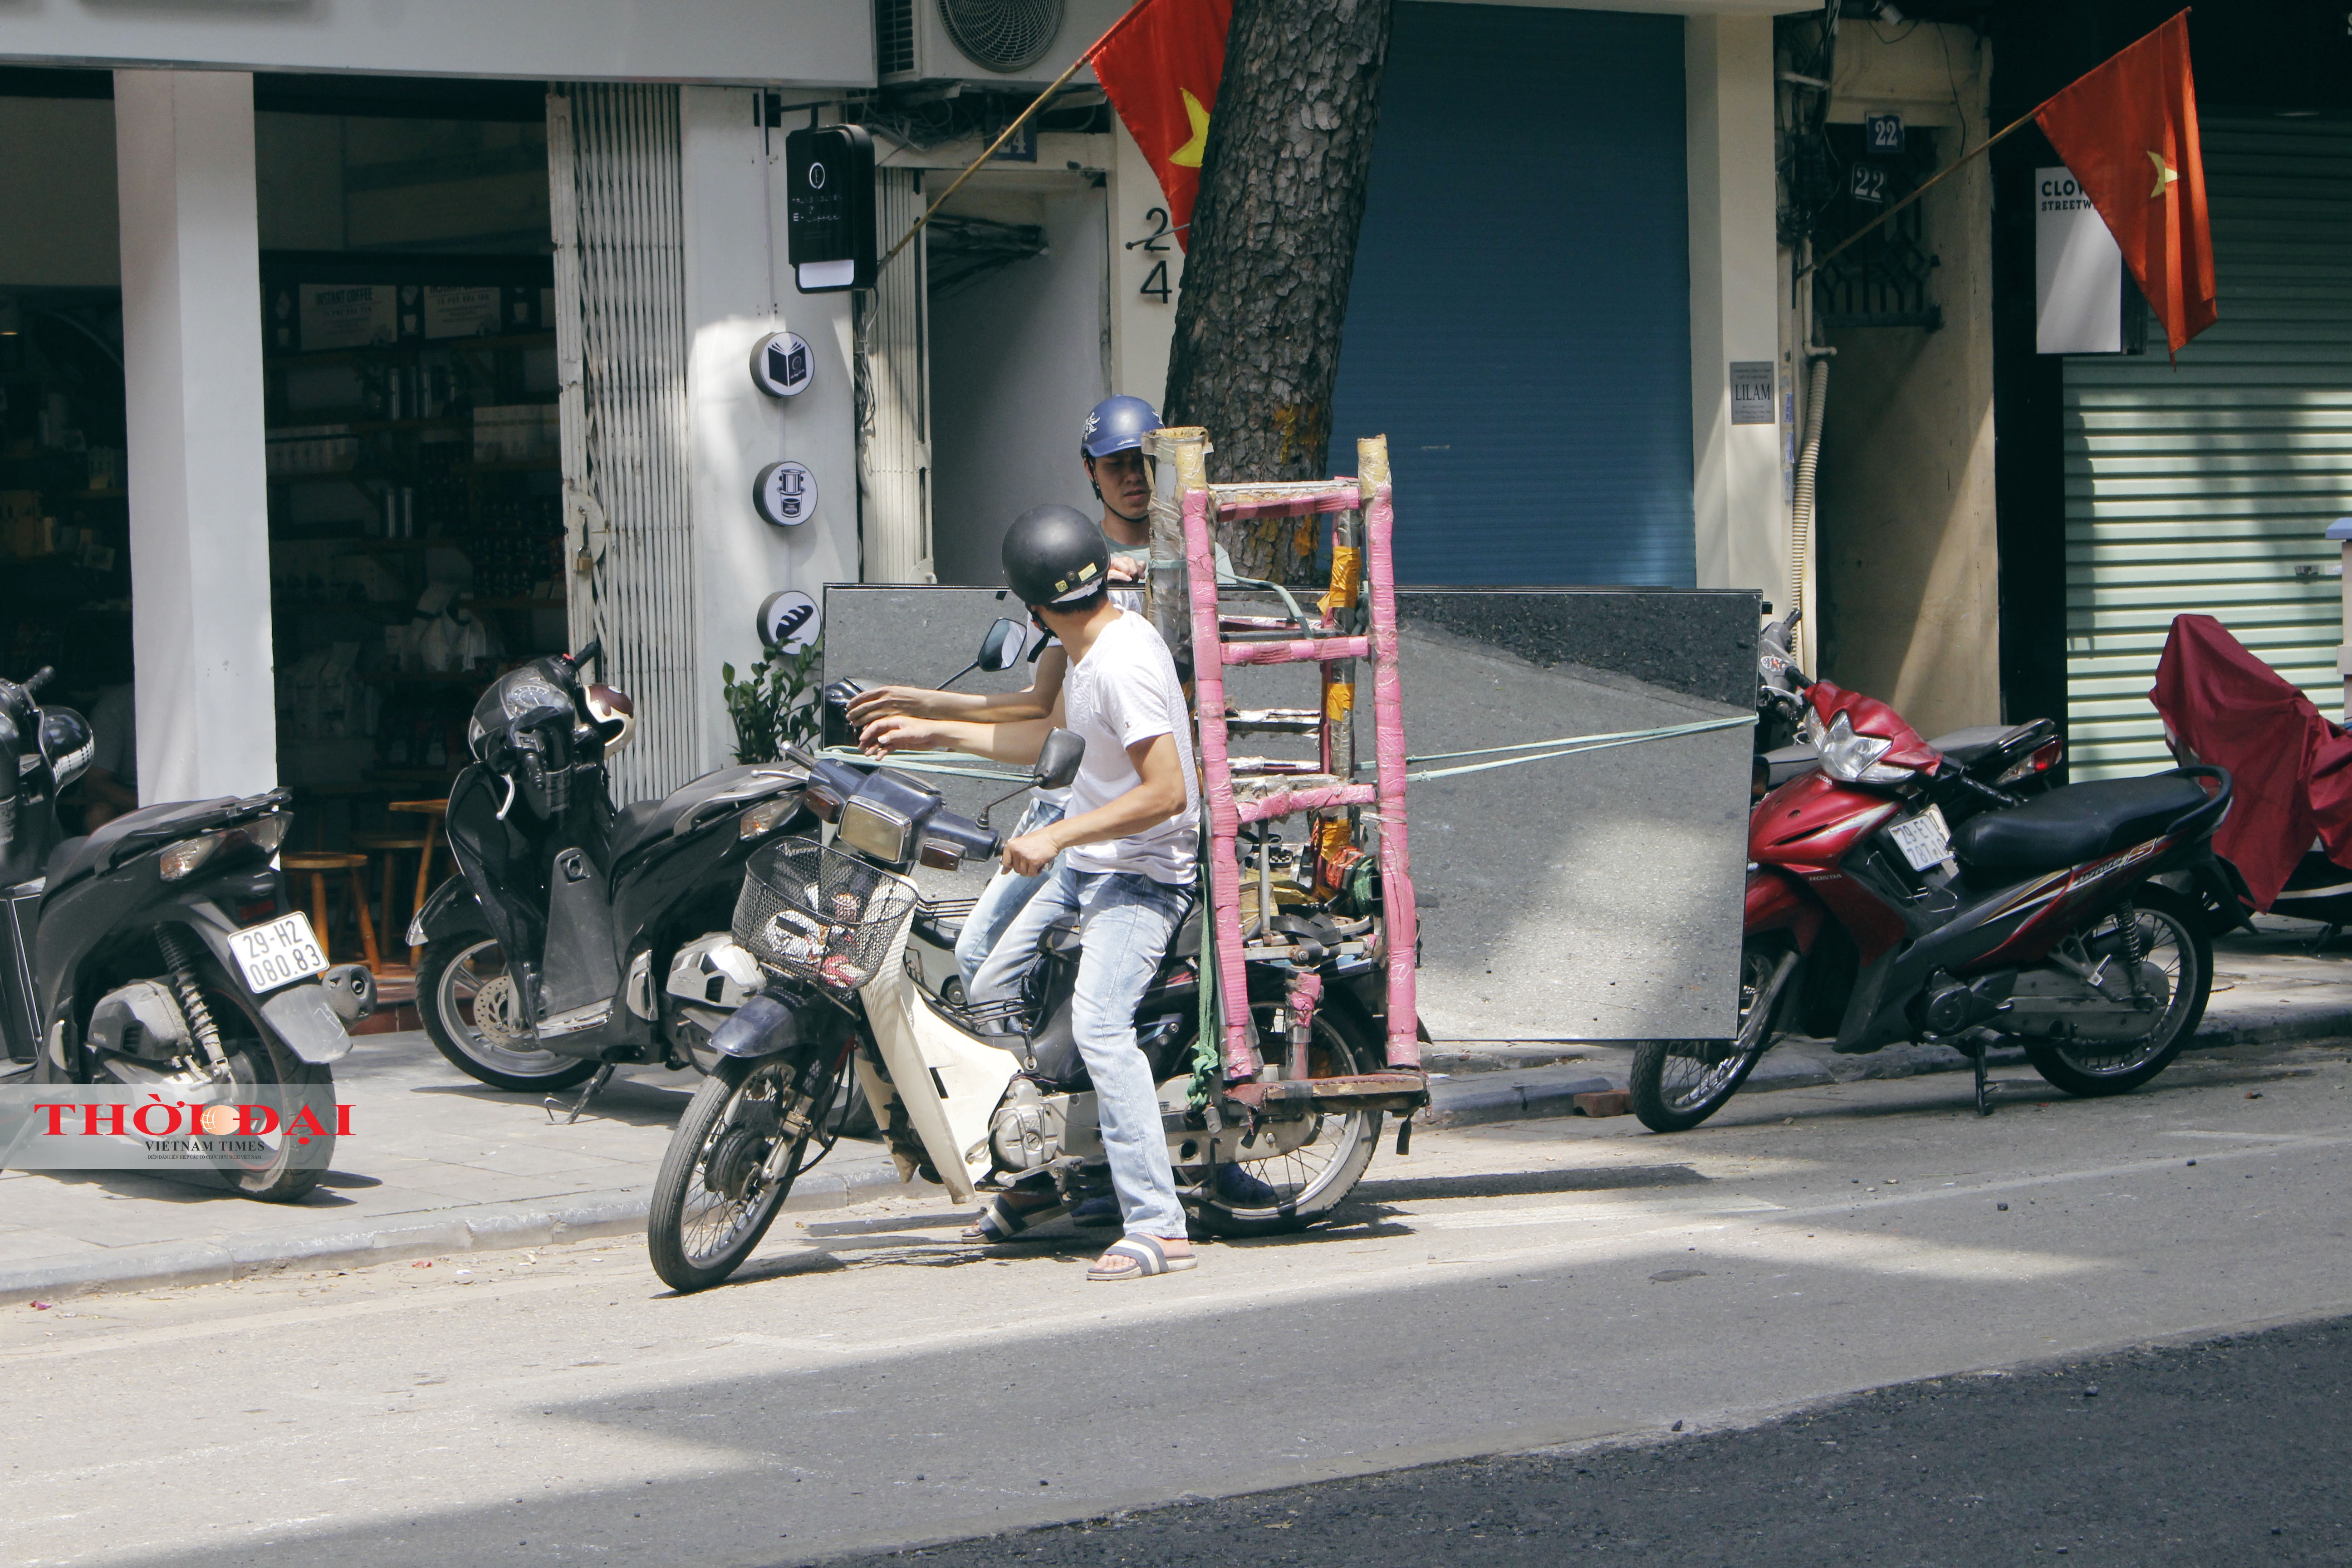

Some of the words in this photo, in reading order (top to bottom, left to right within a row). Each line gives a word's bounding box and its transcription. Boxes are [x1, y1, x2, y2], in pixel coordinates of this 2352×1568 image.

[1875, 120, 1898, 146] 22
[1855, 167, 1884, 199] 22
[2042, 199, 2095, 211] STREETW
[1140, 207, 1172, 304] 24
[346, 287, 372, 303] COFFEE
[1735, 383, 1771, 401] LILAM
[243, 920, 303, 959] 29-H2
[249, 944, 321, 986] 080.83
